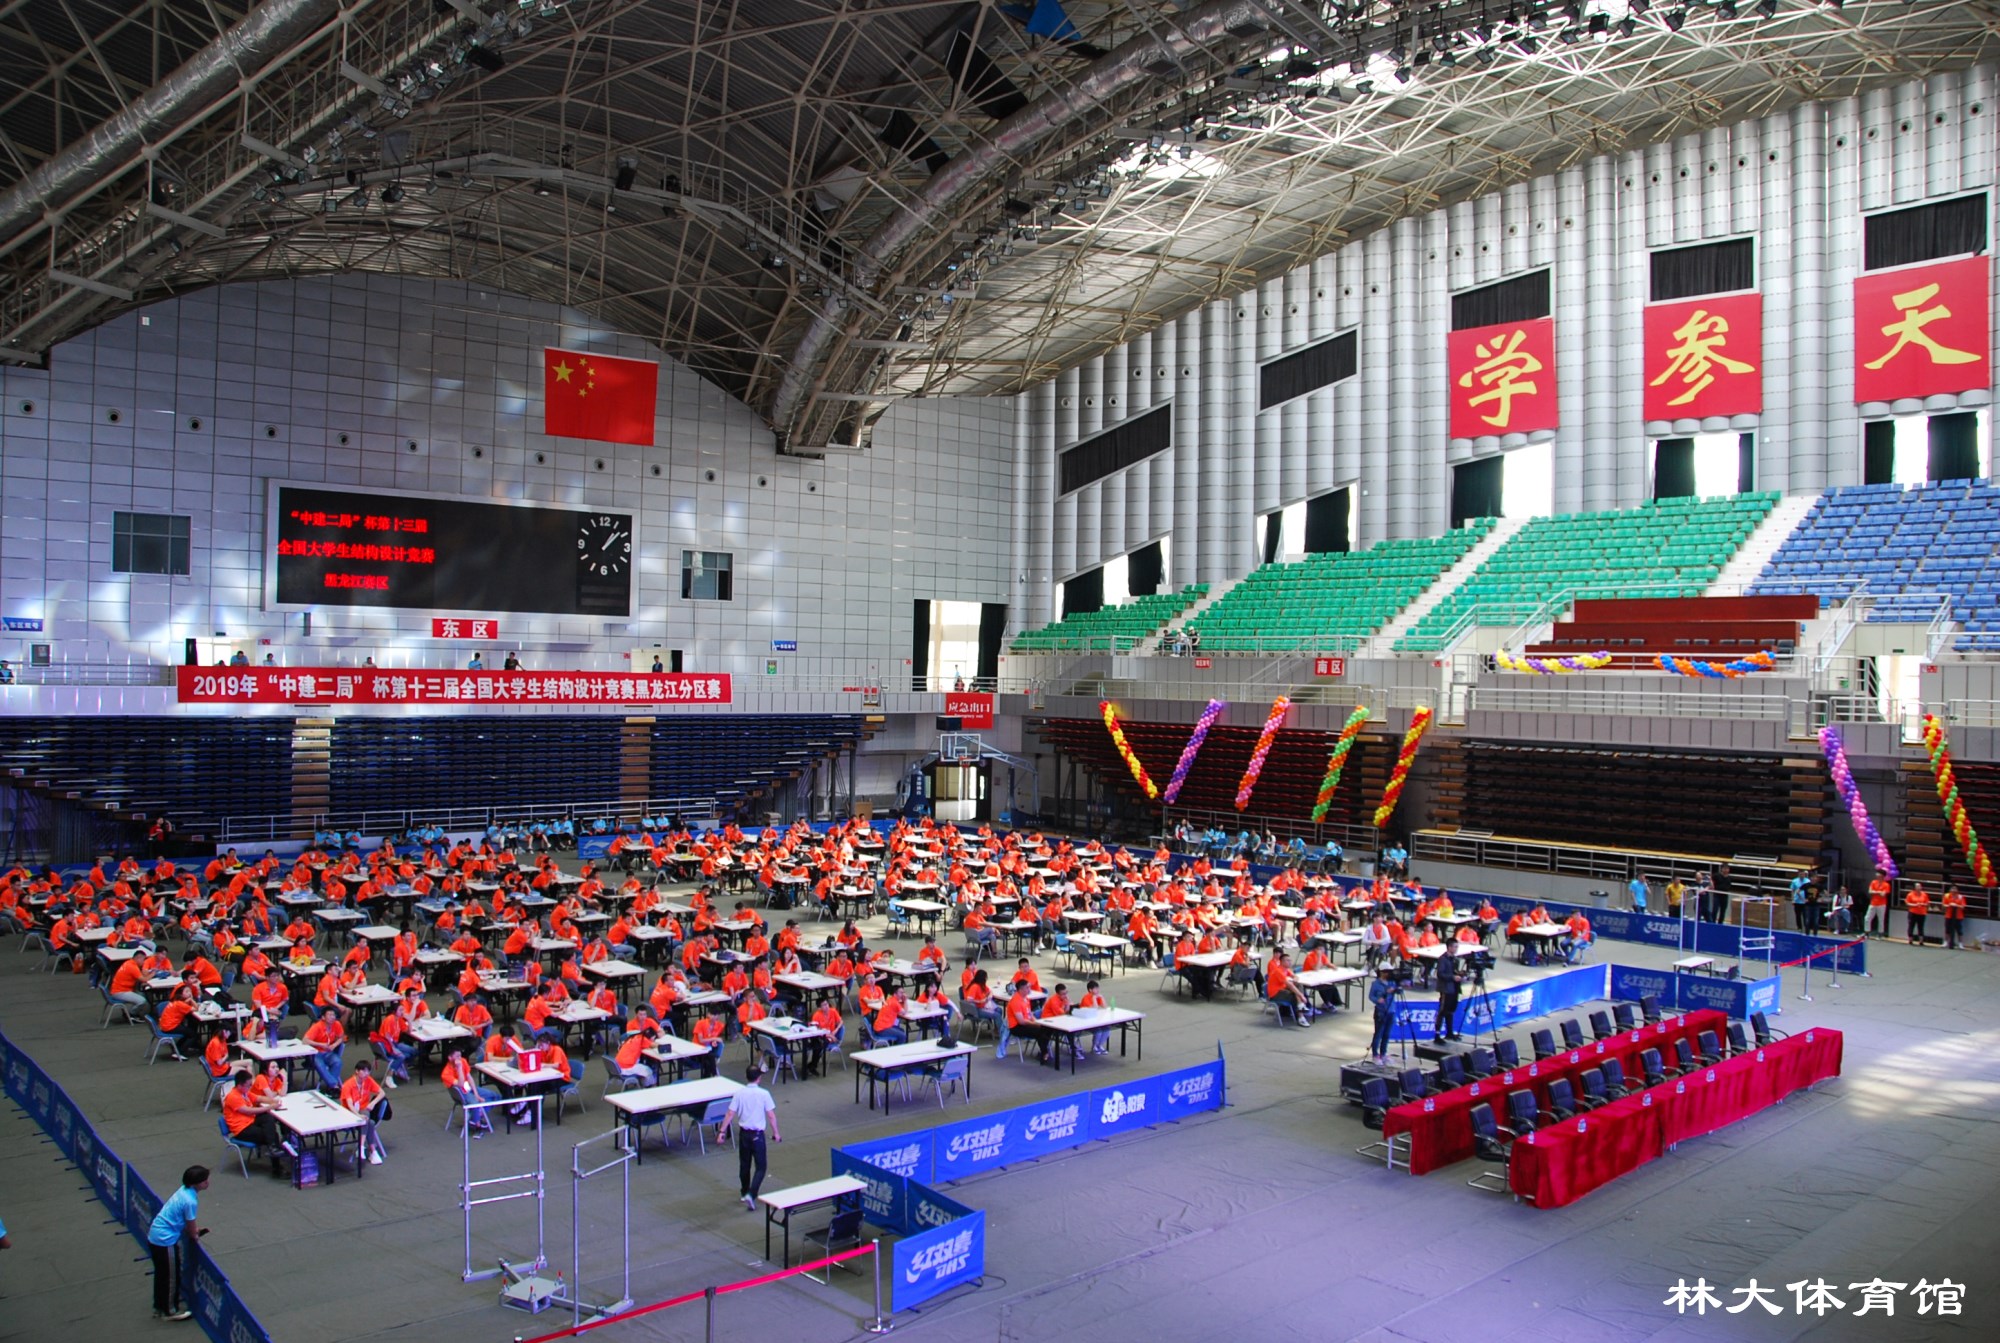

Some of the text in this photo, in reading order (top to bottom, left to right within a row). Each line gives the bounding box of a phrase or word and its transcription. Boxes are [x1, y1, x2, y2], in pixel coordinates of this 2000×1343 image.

[1864, 283, 1982, 370] 天
[1650, 310, 1755, 406] 参
[1459, 329, 1542, 427] 学
[599, 516, 611, 527] 12
[277, 538, 435, 564] 全国大学生结构设计竞赛
[578, 539, 585, 549] 9
[624, 543, 631, 552] 3
[600, 565, 608, 575] 6
[442, 620, 488, 638] 东区
[1317, 660, 1342, 674] 南区
[948, 702, 990, 713] 应急出口
[1025, 1104, 1080, 1142] 红双喜
[1048, 1123, 1077, 1142] DHS
[946, 1124, 1006, 1162] 红双喜
[972, 1144, 1003, 1162] DHS
[915, 1200, 962, 1226] 红双
[906, 1229, 973, 1284] 红双喜
[935, 1253, 970, 1280] DHS
